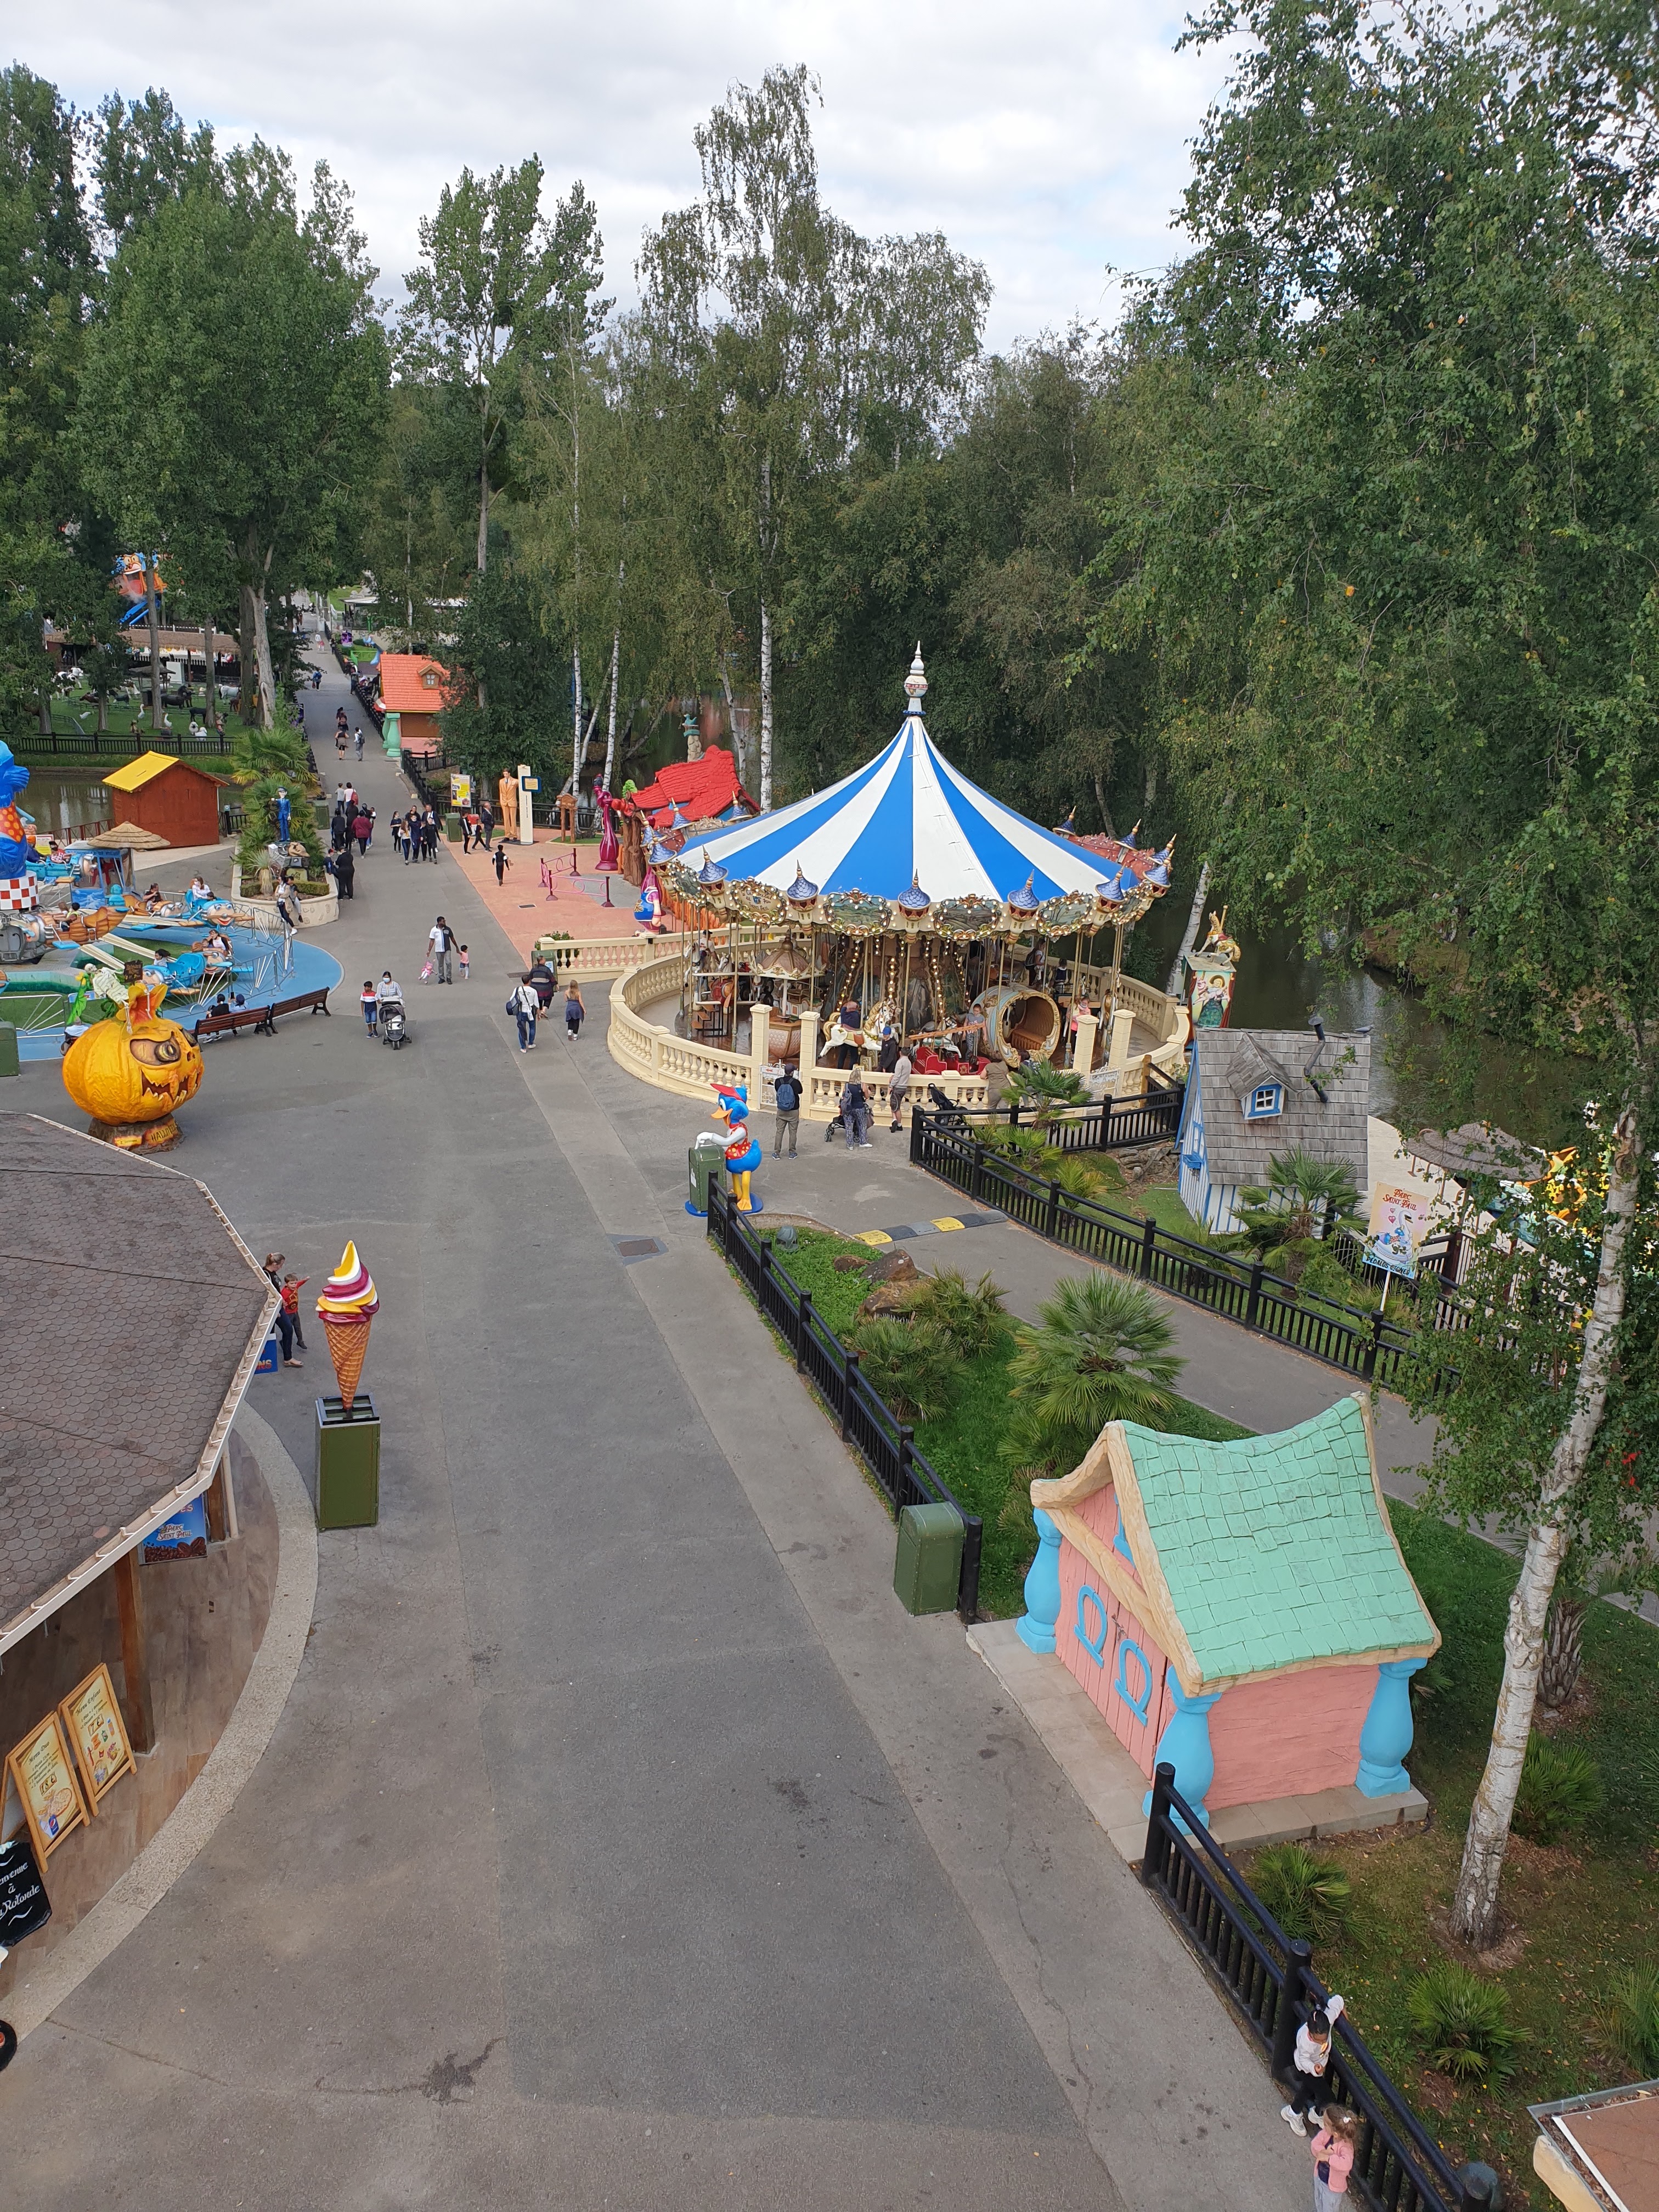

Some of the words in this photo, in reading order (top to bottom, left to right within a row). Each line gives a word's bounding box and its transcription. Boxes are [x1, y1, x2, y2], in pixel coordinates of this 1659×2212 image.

[1393, 1189, 1412, 1200] PARC
[8, 1883, 16, 1894] à
[1, 1884, 40, 1916] Rotonde
